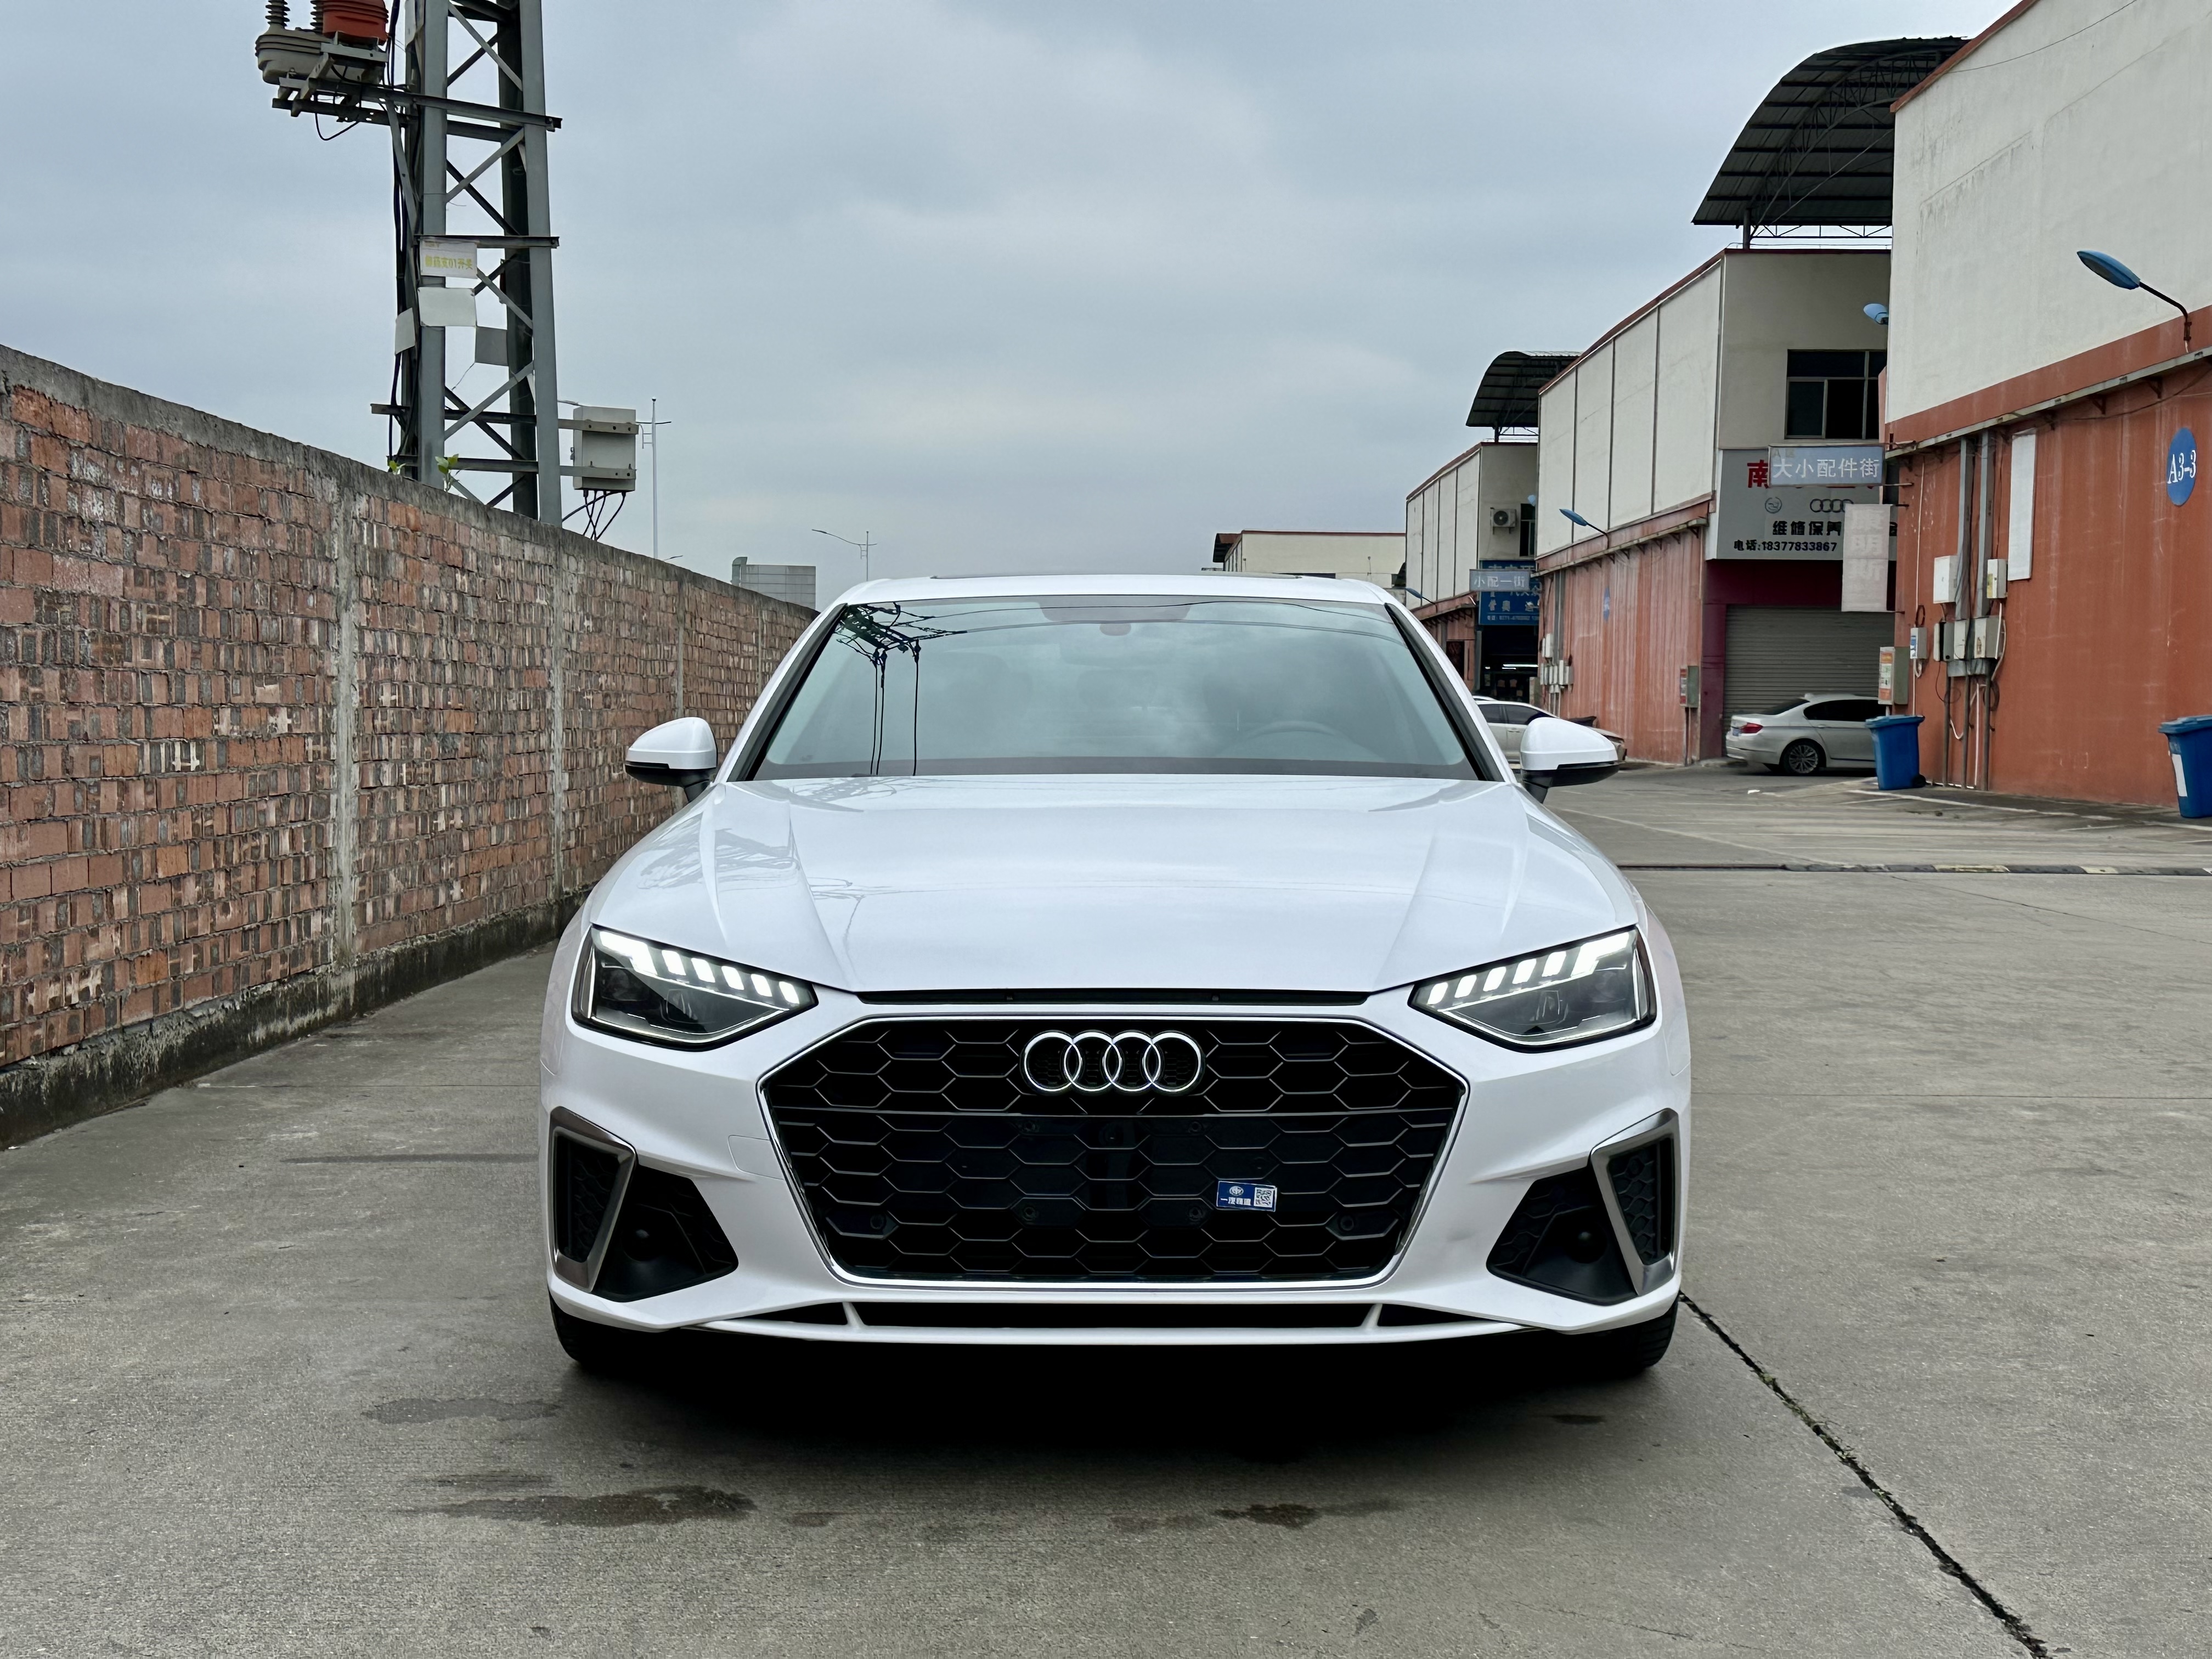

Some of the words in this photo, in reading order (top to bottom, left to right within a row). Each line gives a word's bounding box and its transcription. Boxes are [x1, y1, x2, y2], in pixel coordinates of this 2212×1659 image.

[1773, 458, 1880, 478] 大小配件街
[2167, 450, 2196, 484] A3-3
[1474, 575, 1525, 588] 小配一街
